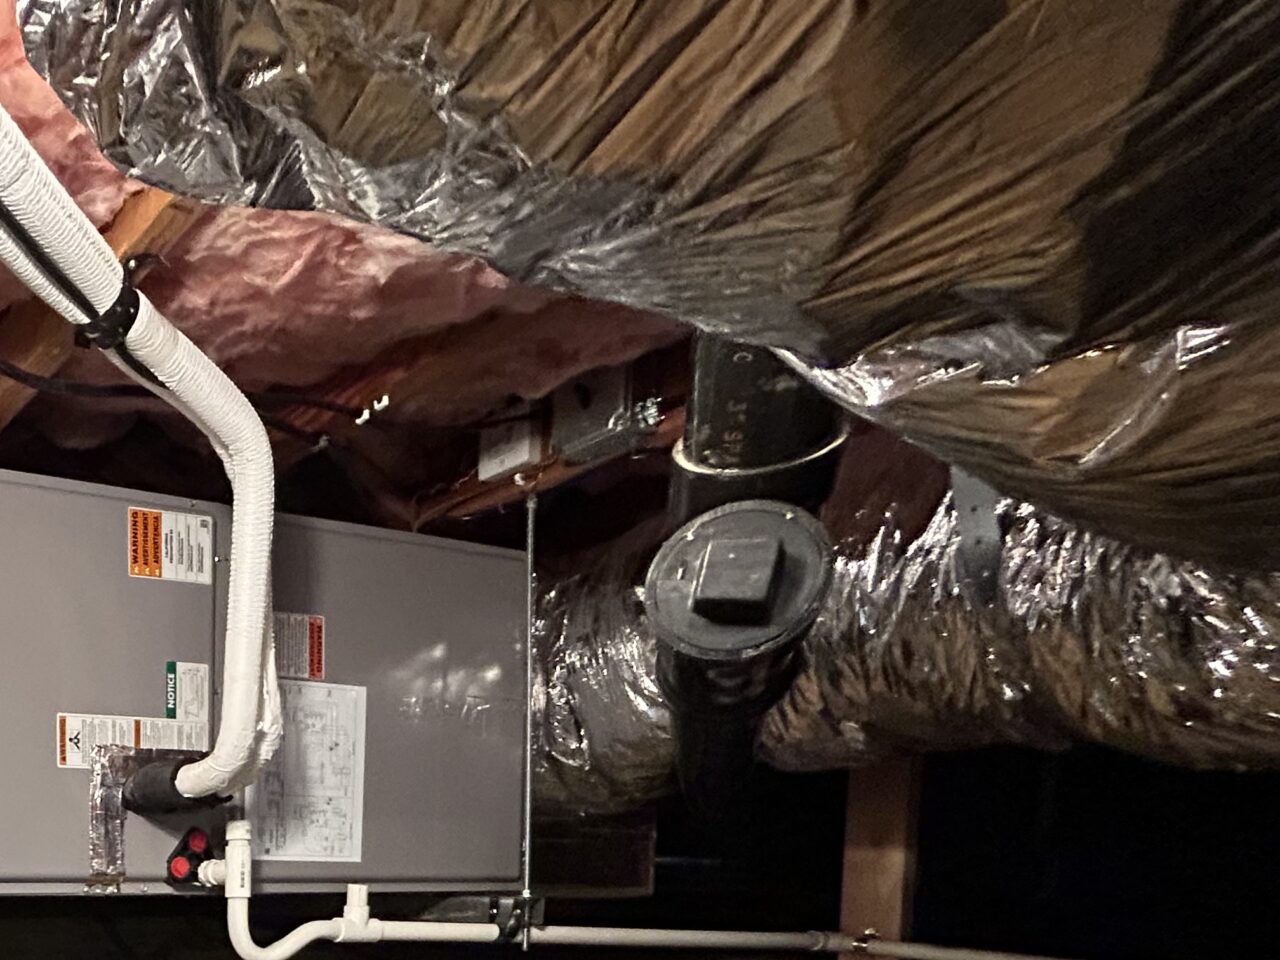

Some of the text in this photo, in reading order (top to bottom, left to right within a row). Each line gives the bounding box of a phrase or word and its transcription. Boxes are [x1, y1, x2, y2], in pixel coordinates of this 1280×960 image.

[131, 511, 140, 565] WARNING
[142, 512, 150, 566] AVERTISSEMENT
[152, 515, 160, 564] ADVERTENCIA
[166, 672, 176, 709] NOTICE
